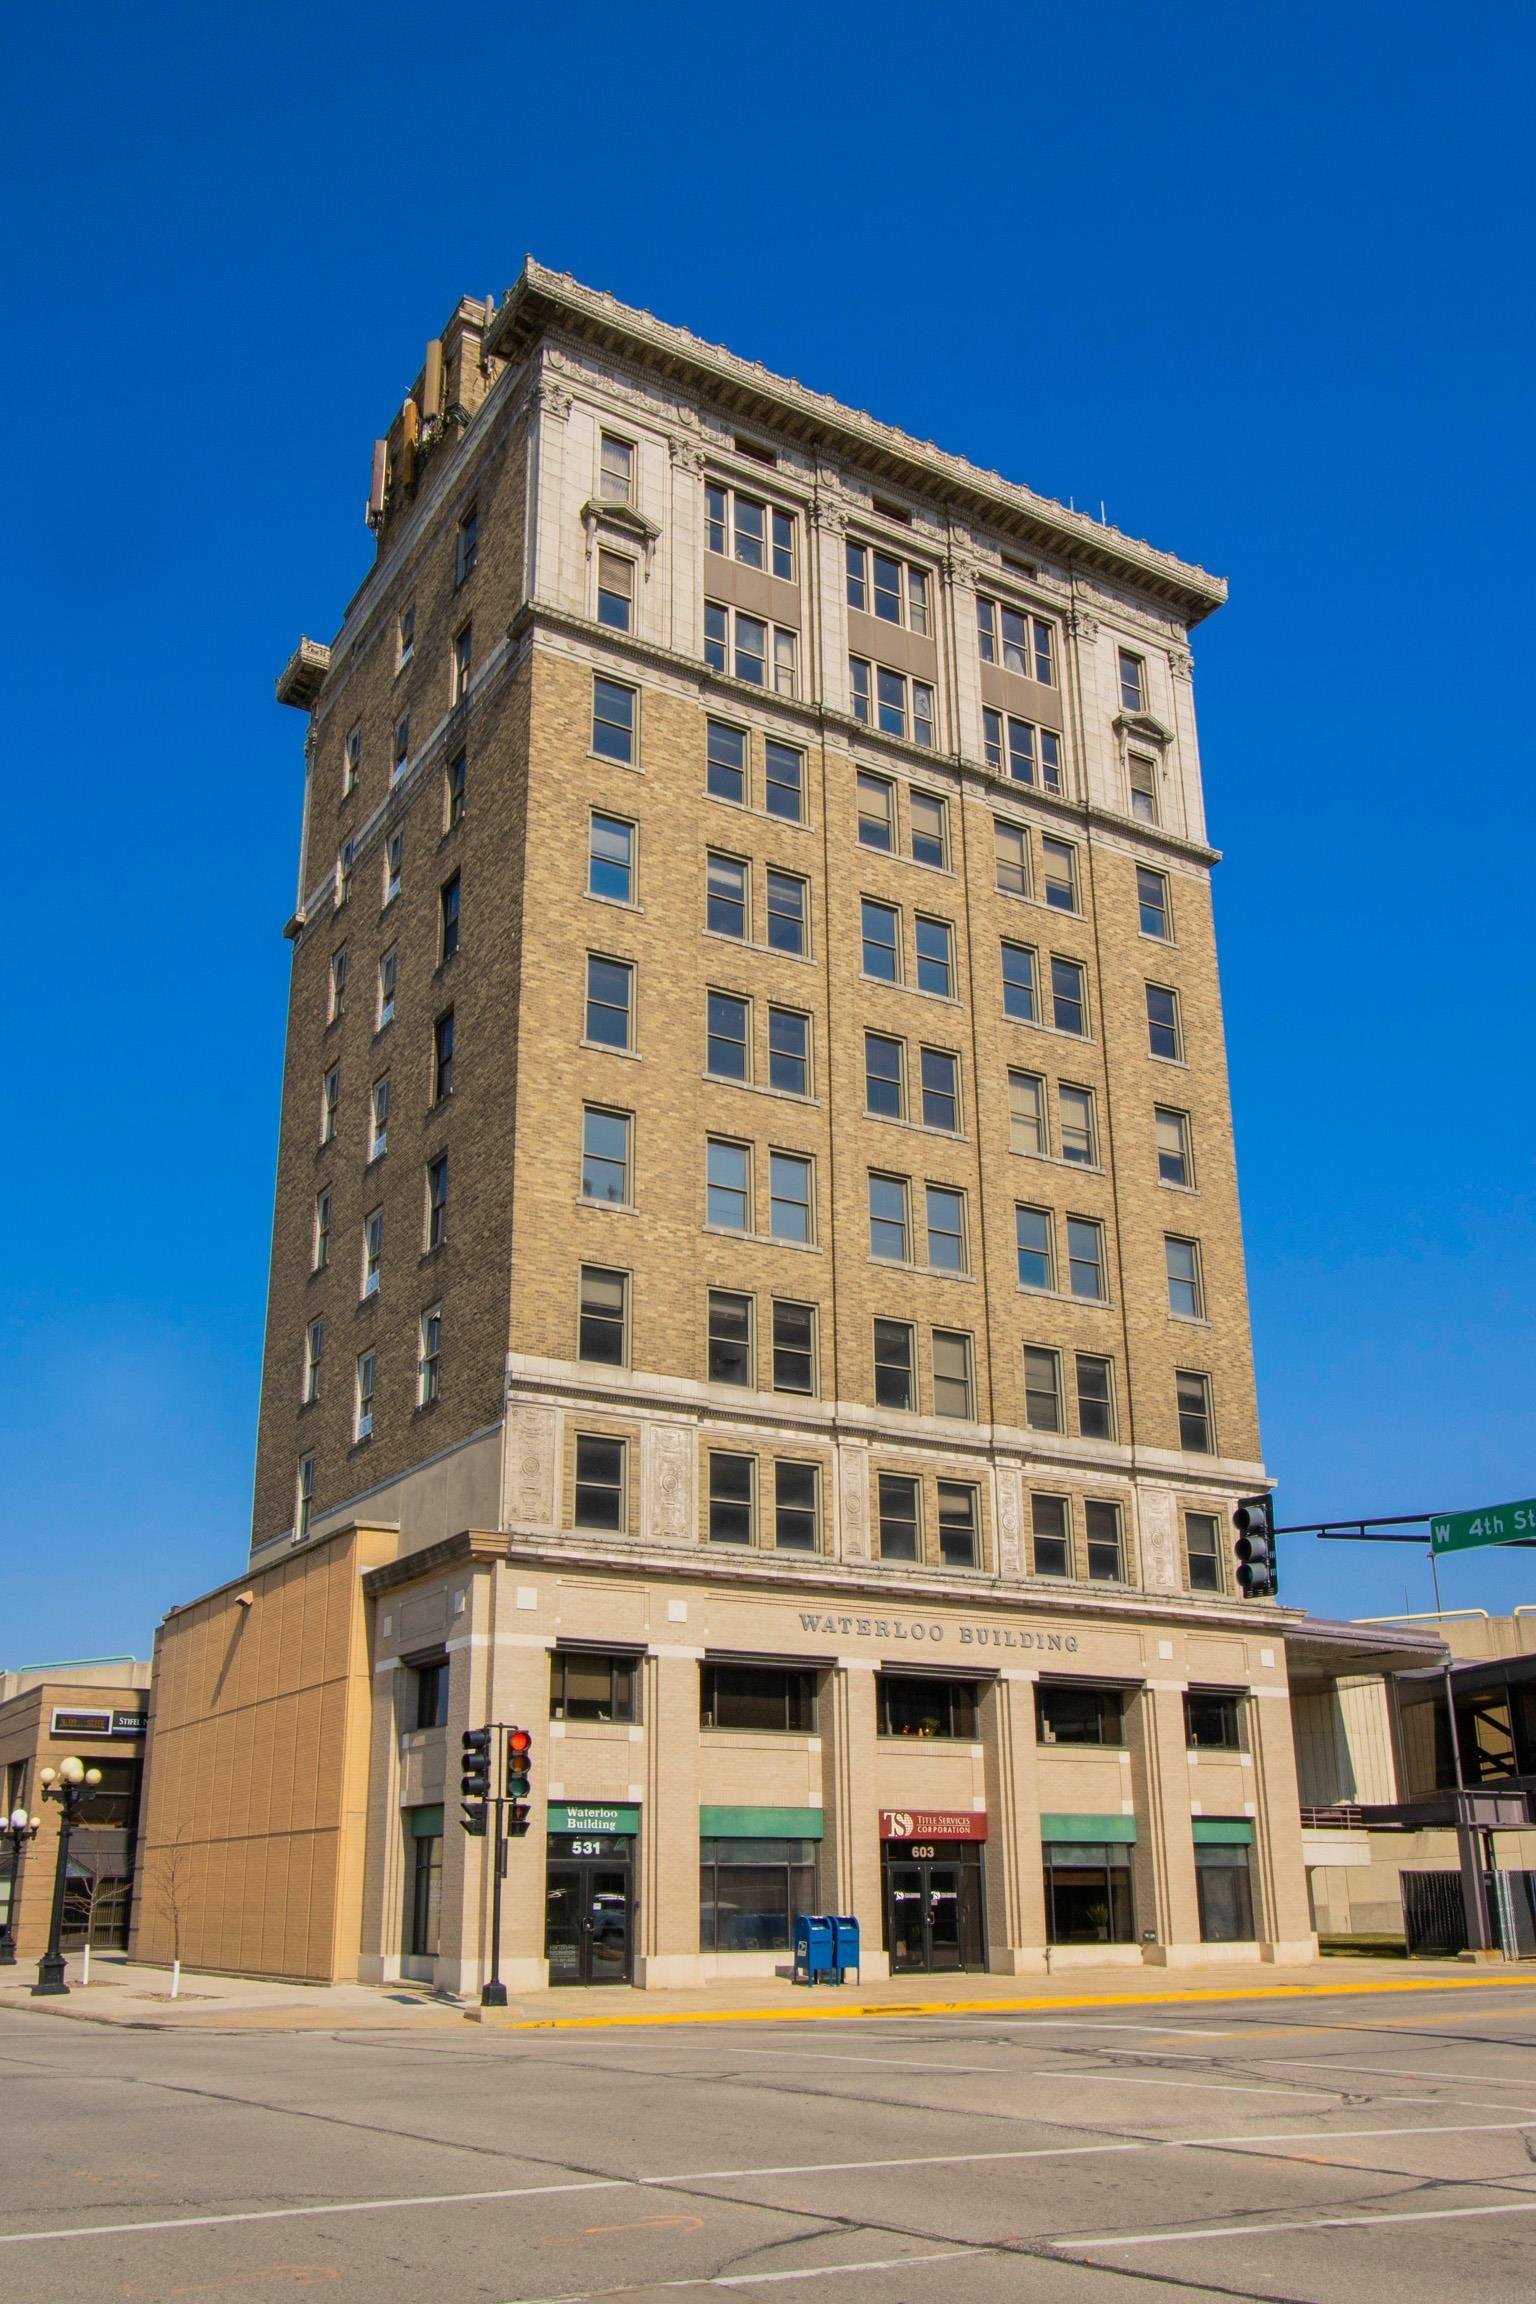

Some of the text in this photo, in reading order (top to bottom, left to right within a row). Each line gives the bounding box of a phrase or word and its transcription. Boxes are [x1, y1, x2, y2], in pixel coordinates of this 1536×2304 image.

[1434, 1508, 1536, 1544] W 4th St
[799, 1613, 1079, 1653] WATERLOO BUILDING
[119, 1717, 140, 1726] STIFEL
[566, 1806, 618, 1818] Waterloo
[567, 1818, 616, 1831] Building
[917, 1825, 971, 1834] CORPORATION
[571, 1841, 600, 1855] 531
[911, 1846, 935, 1858] 603
